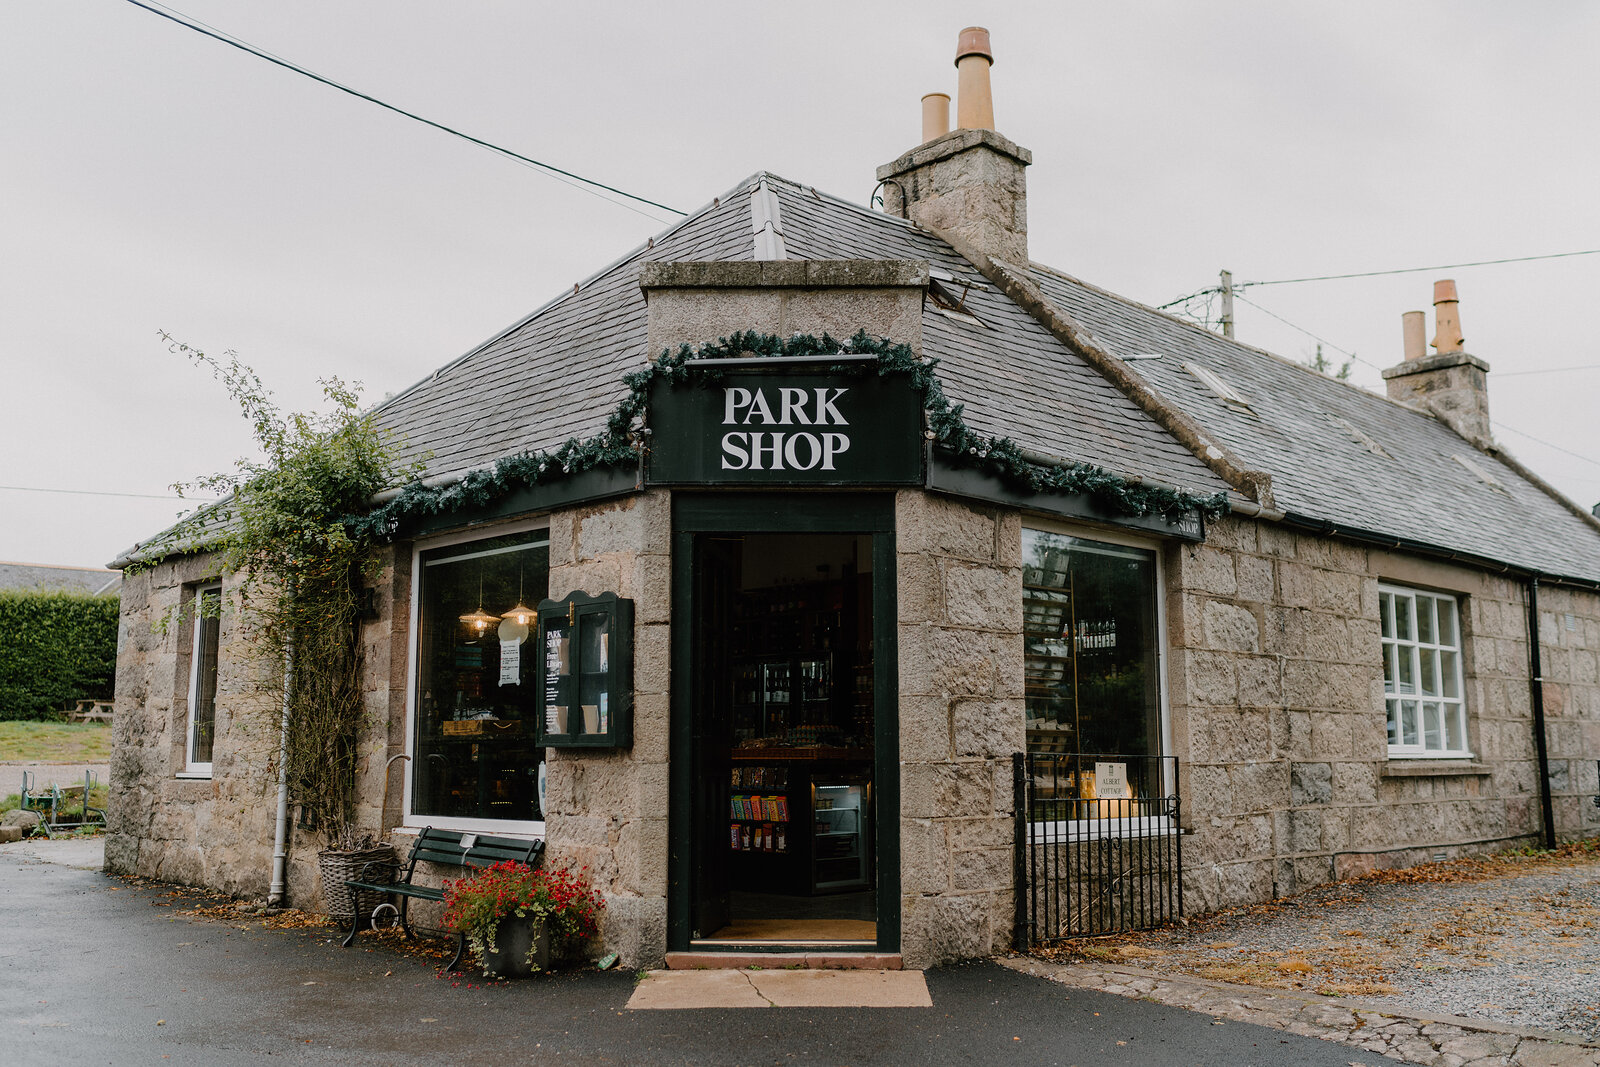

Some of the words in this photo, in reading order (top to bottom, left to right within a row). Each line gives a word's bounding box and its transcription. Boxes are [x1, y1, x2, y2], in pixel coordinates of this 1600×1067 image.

[721, 387, 850, 425] PARK
[721, 432, 851, 471] SHOP
[1178, 520, 1198, 534] SHOP
[547, 630, 562, 639] PARK
[547, 639, 562, 648] SHOP
